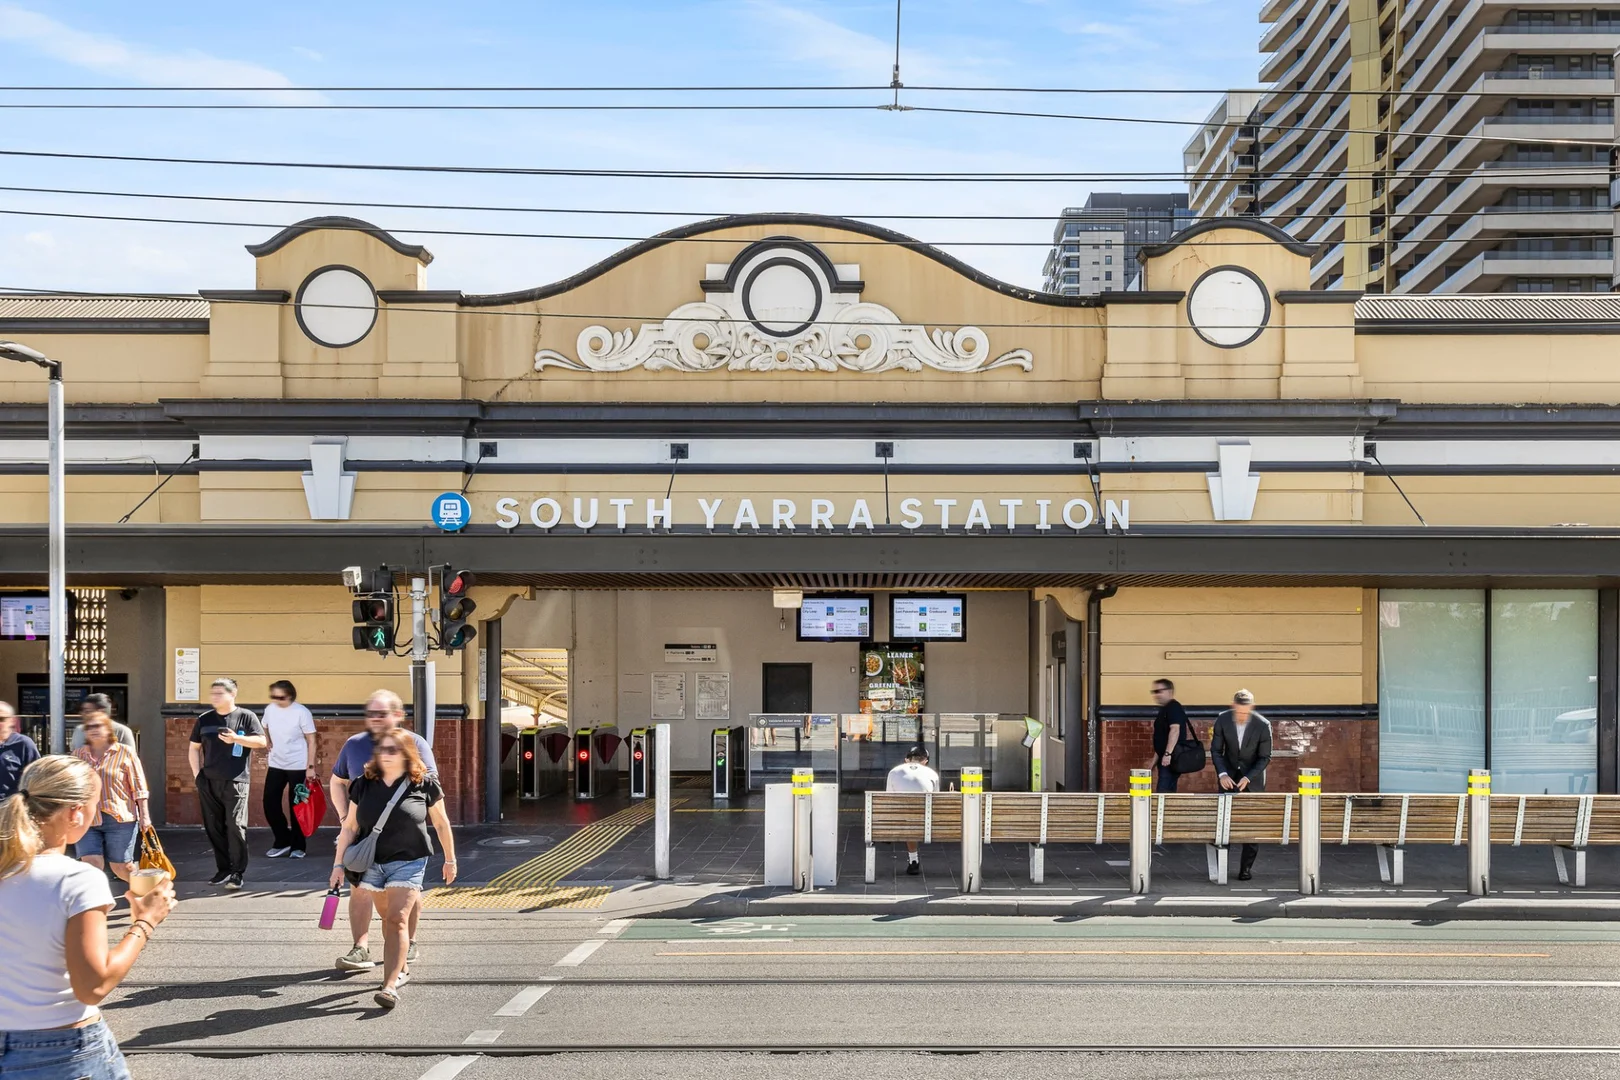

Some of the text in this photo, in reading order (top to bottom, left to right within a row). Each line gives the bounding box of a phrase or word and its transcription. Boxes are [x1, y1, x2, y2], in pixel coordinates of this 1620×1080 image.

[496, 497, 1130, 530] SOUTH YARRA STATION
